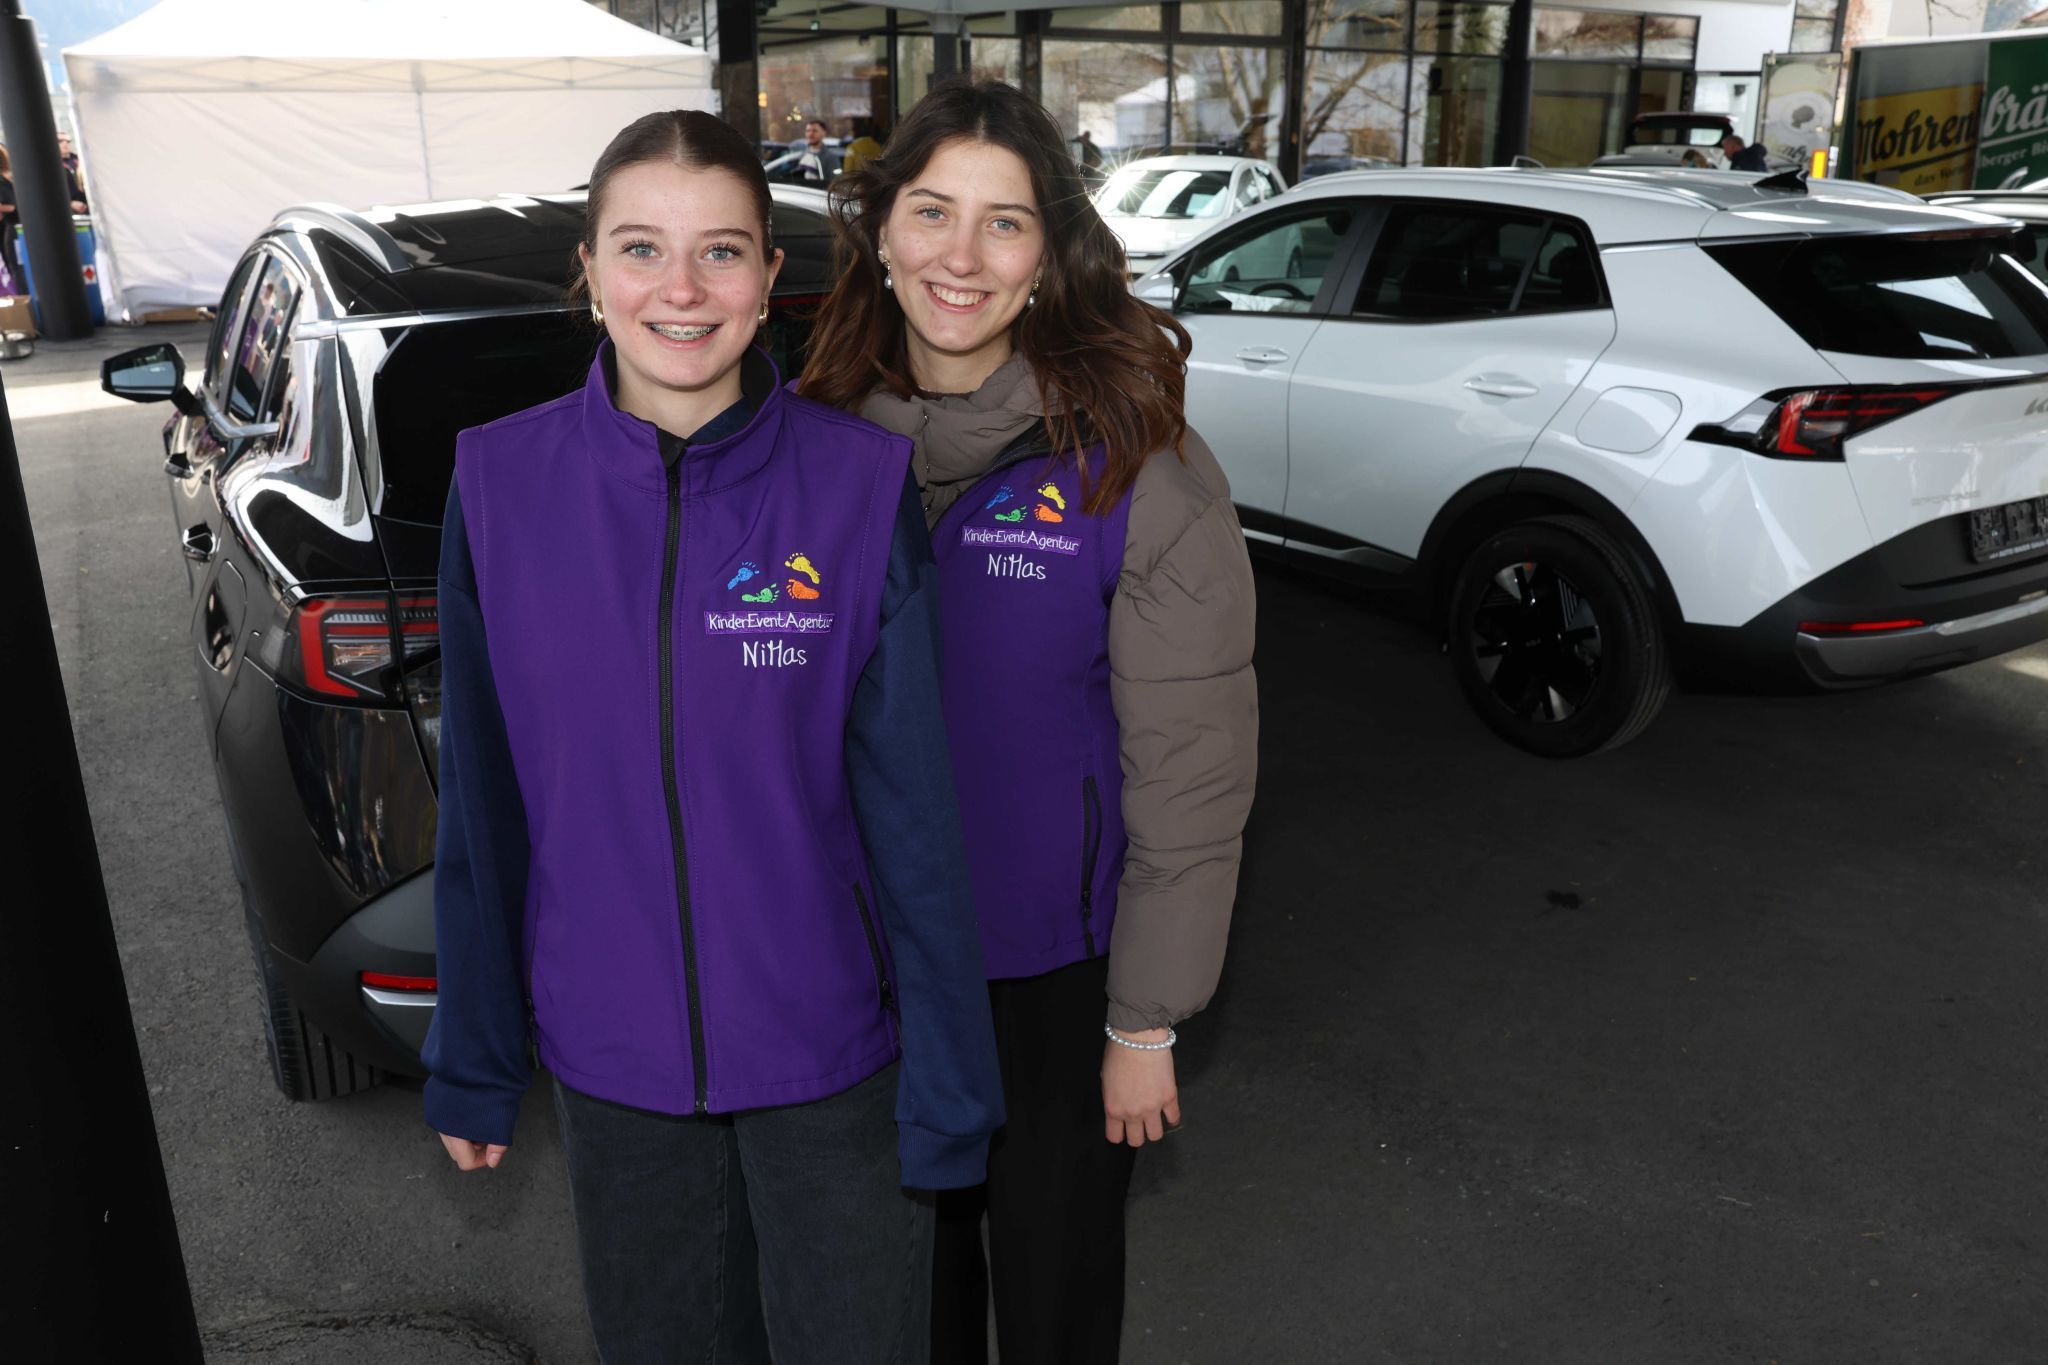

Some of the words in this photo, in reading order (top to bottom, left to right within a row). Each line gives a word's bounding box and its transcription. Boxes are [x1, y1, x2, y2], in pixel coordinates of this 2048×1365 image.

[1983, 82, 2048, 138] brä
[964, 529, 1080, 551] KinderEventAgentur
[708, 612, 833, 632] KinderEventAgentur
